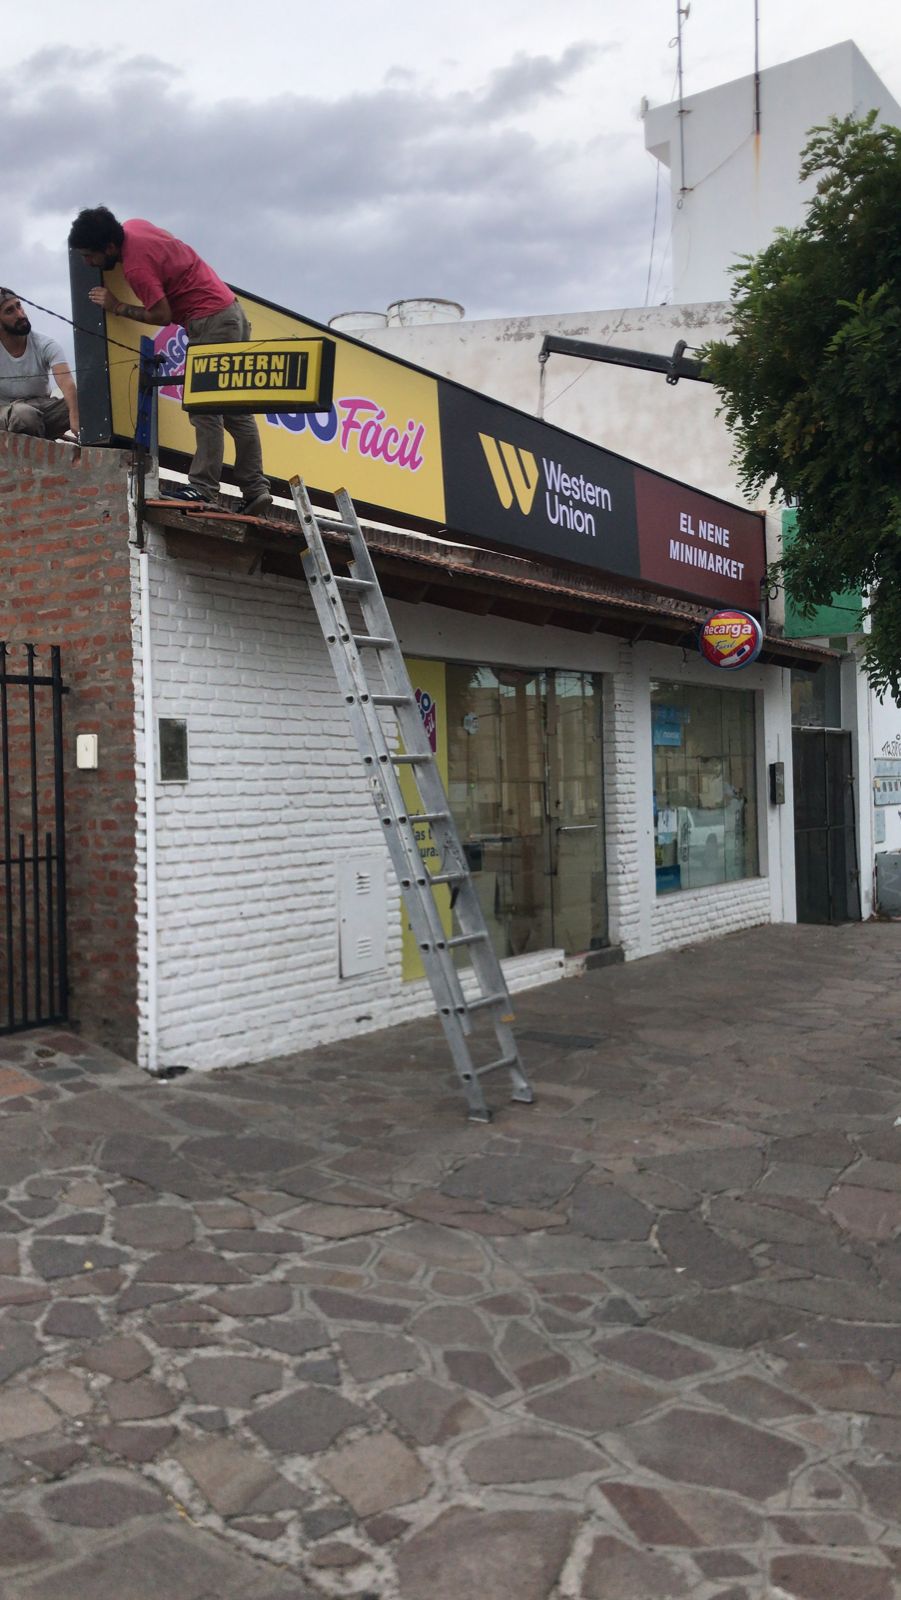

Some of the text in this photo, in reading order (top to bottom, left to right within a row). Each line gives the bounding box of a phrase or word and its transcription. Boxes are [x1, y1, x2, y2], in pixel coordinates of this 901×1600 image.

[194, 354, 285, 374] WESTERN
[218, 371, 284, 388] UNION
[338, 399, 425, 471] Fácil
[542, 457, 612, 512] Western
[545, 491, 596, 537] Union
[679, 512, 730, 548] EL NENE
[669, 539, 744, 581] MINIMARKET
[703, 623, 752, 638] Recarga
